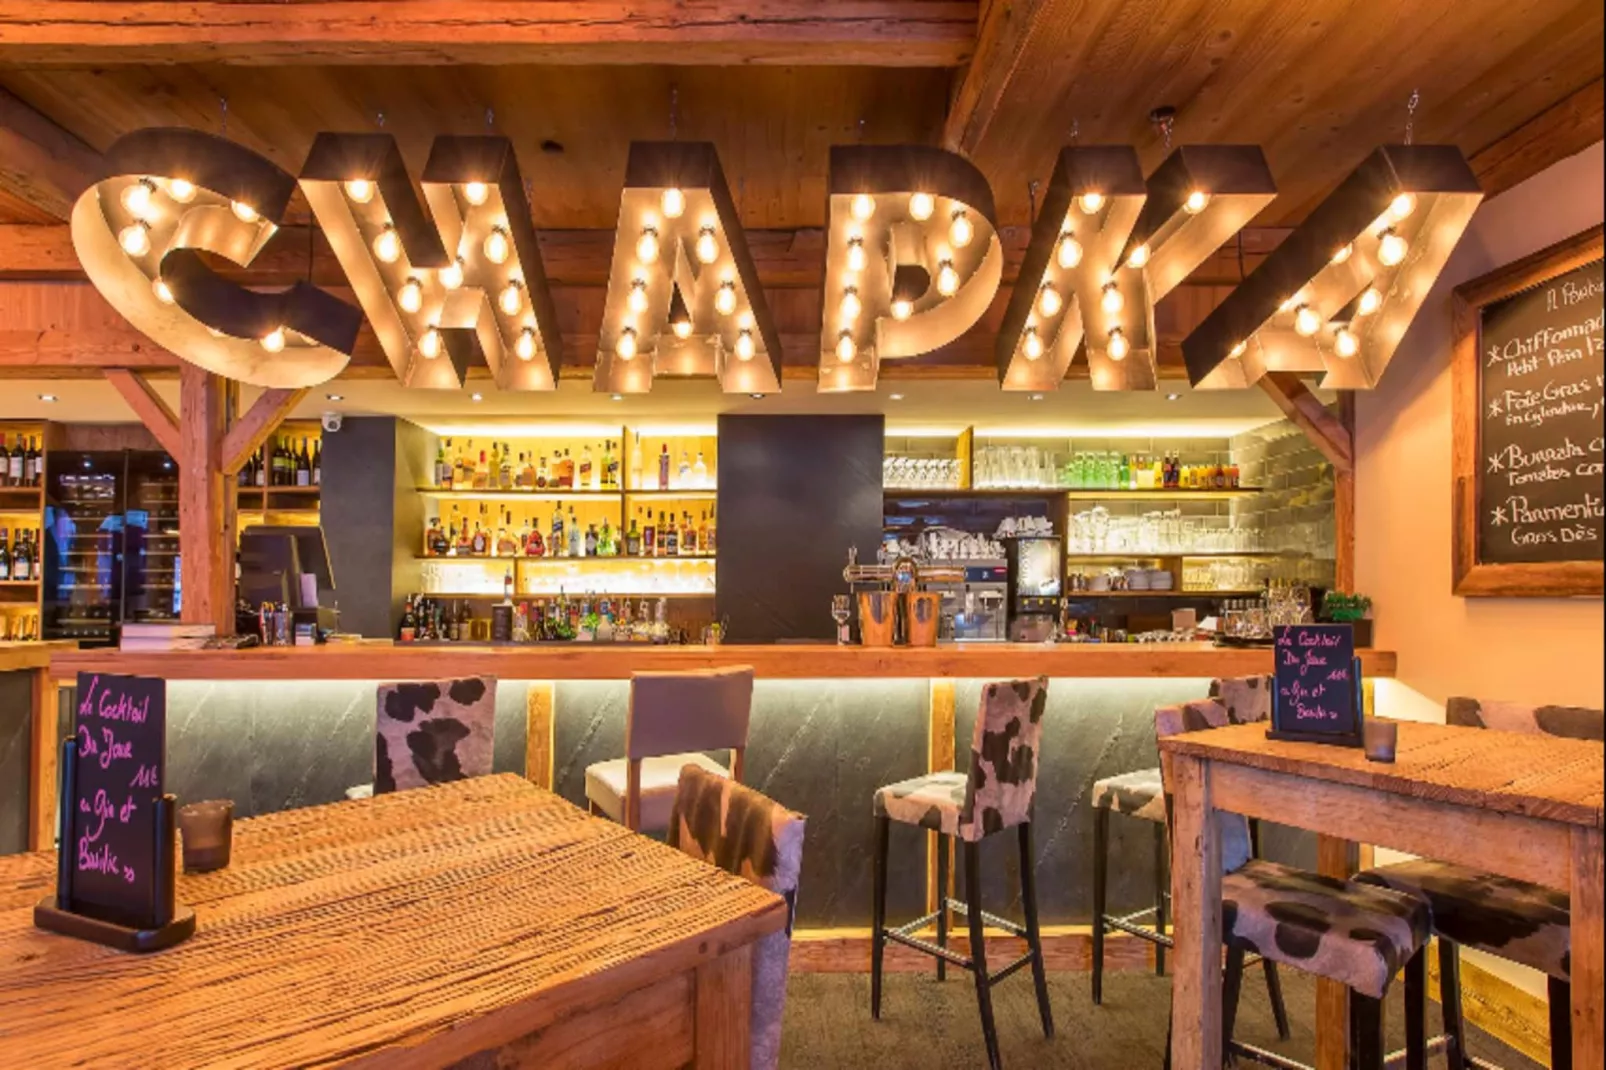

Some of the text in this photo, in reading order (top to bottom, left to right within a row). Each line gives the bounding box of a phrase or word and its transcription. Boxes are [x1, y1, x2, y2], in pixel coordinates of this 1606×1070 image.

[71, 127, 1485, 393] CHAPKA
[1543, 378, 1592, 400] Gras
[1503, 437, 1586, 470] Burrata
[1507, 465, 1571, 486] Tomates
[99, 687, 149, 724] Cocktail
[78, 724, 98, 758] Du
[120, 795, 137, 823] et
